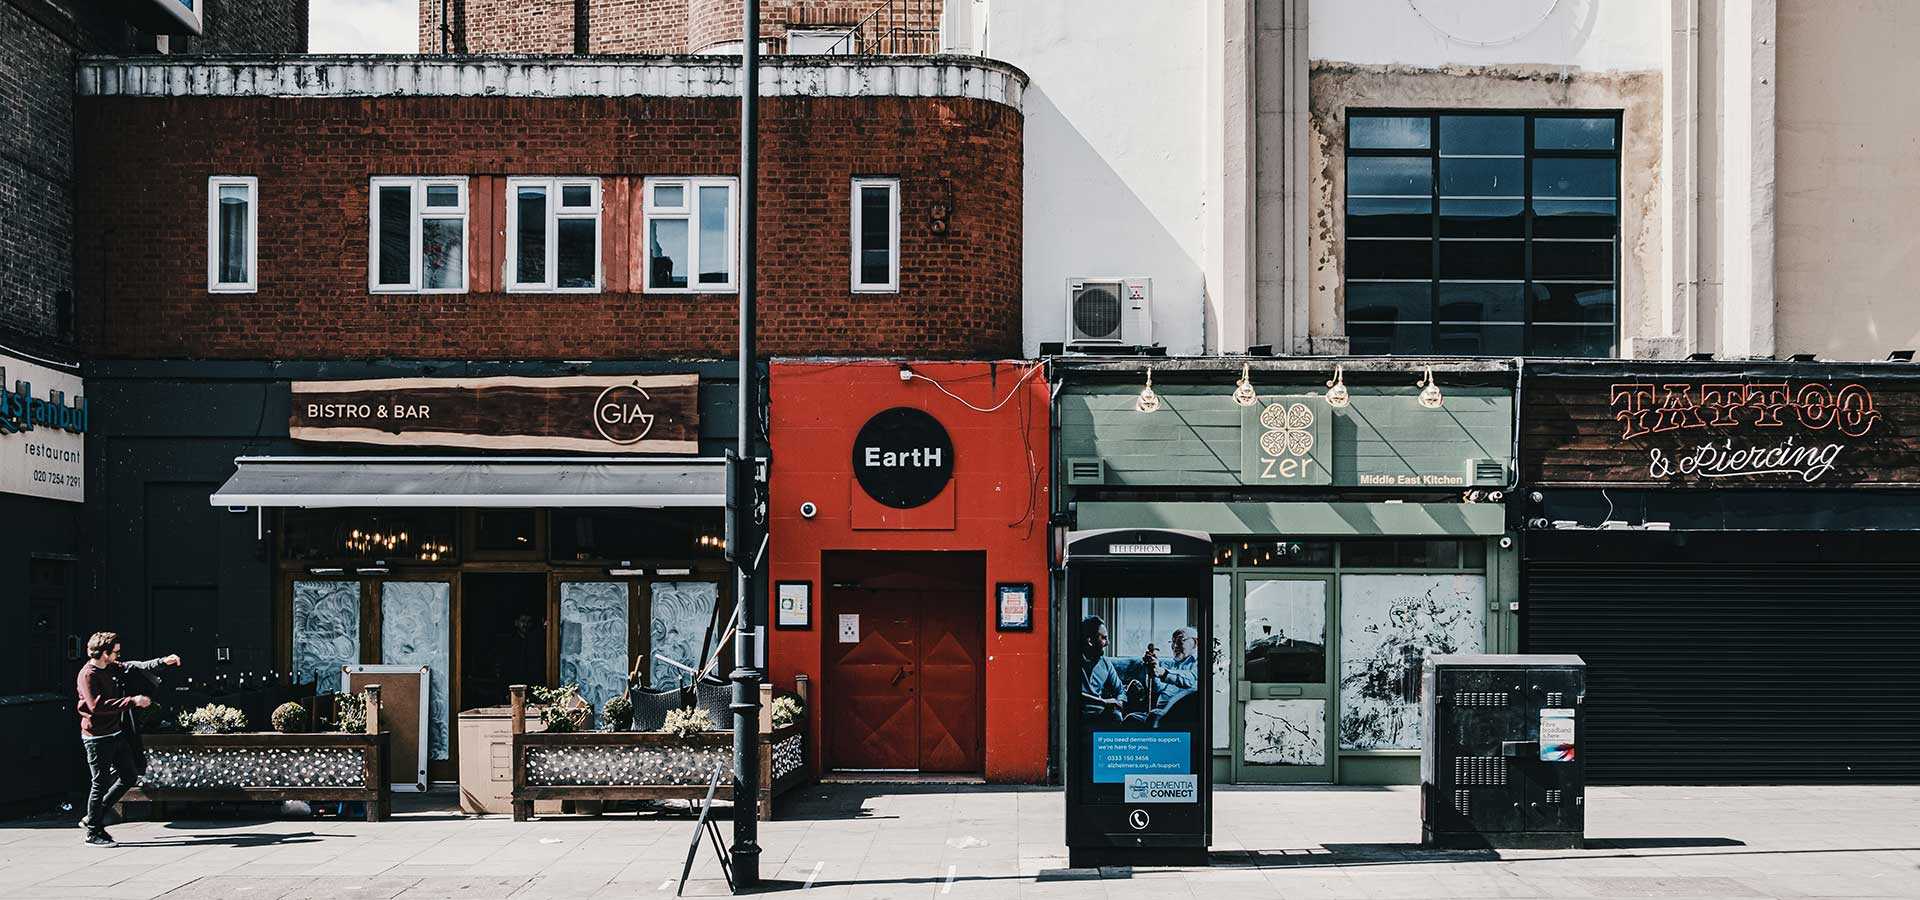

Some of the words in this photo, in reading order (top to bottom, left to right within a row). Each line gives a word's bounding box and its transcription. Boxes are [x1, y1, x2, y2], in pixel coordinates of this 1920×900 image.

[307, 403, 371, 419] BISTRO
[376, 404, 389, 419] &
[394, 404, 430, 419] BAR
[1610, 383, 1882, 440] TATTOO
[25, 443, 80, 464] restaurant
[865, 447, 941, 467] EartH
[1649, 448, 1676, 478] &
[1680, 436, 1845, 482] Piercing
[1260, 457, 1313, 479] zer
[33, 470, 46, 482] 020
[48, 472, 64, 485] 7254
[1360, 474, 1395, 485] Middle
[1397, 474, 1421, 485] East
[1423, 474, 1463, 485] Kitchen
[1112, 544, 1169, 553] TELEPHONE
[1149, 781, 1194, 789] DEMENTIA
[1150, 789, 1194, 798] CONNECT
